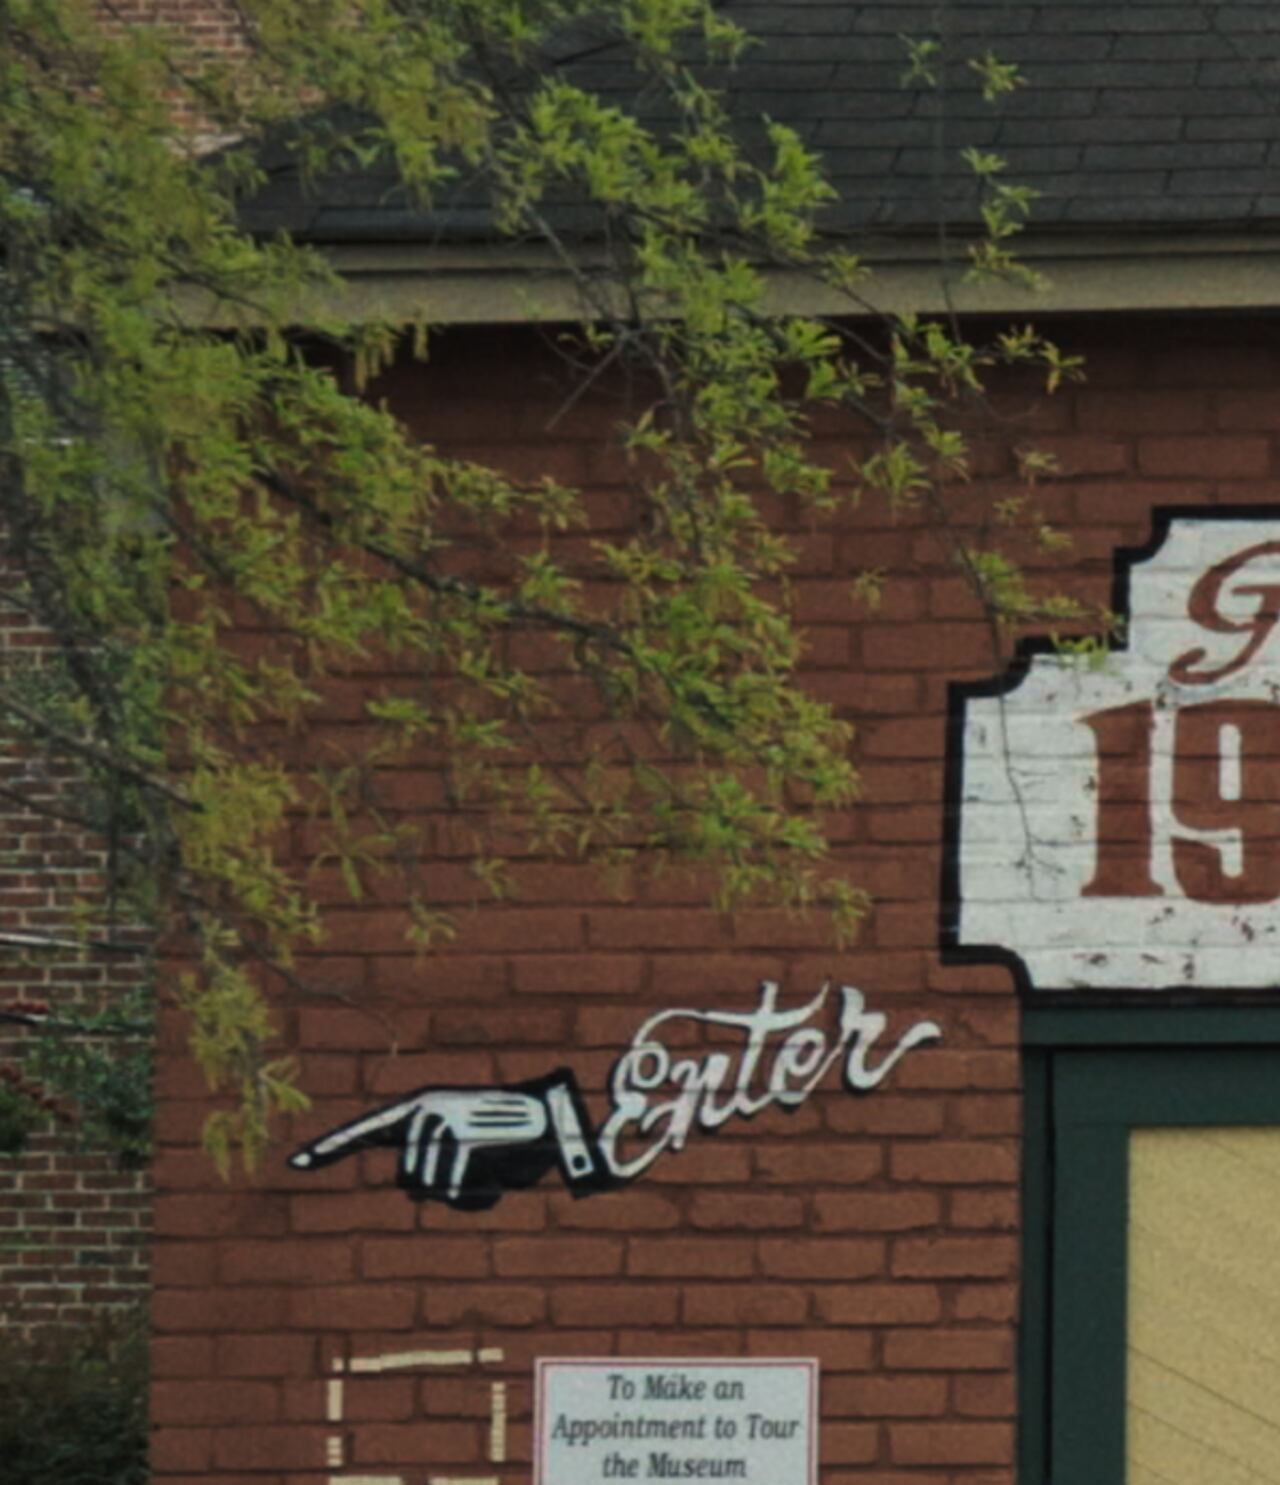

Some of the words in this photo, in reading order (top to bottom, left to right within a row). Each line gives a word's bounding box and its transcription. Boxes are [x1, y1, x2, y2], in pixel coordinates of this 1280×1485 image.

[600, 980, 942, 1178] Enter
[607, 1375, 636, 1401] To
[643, 1373, 706, 1401] Make
[714, 1381, 745, 1401] an
[551, 1412, 705, 1446] Appointment
[714, 1416, 738, 1439] to
[746, 1413, 800, 1439] Tour
[602, 1452, 640, 1479] the
[646, 1453, 747, 1480] Museum
